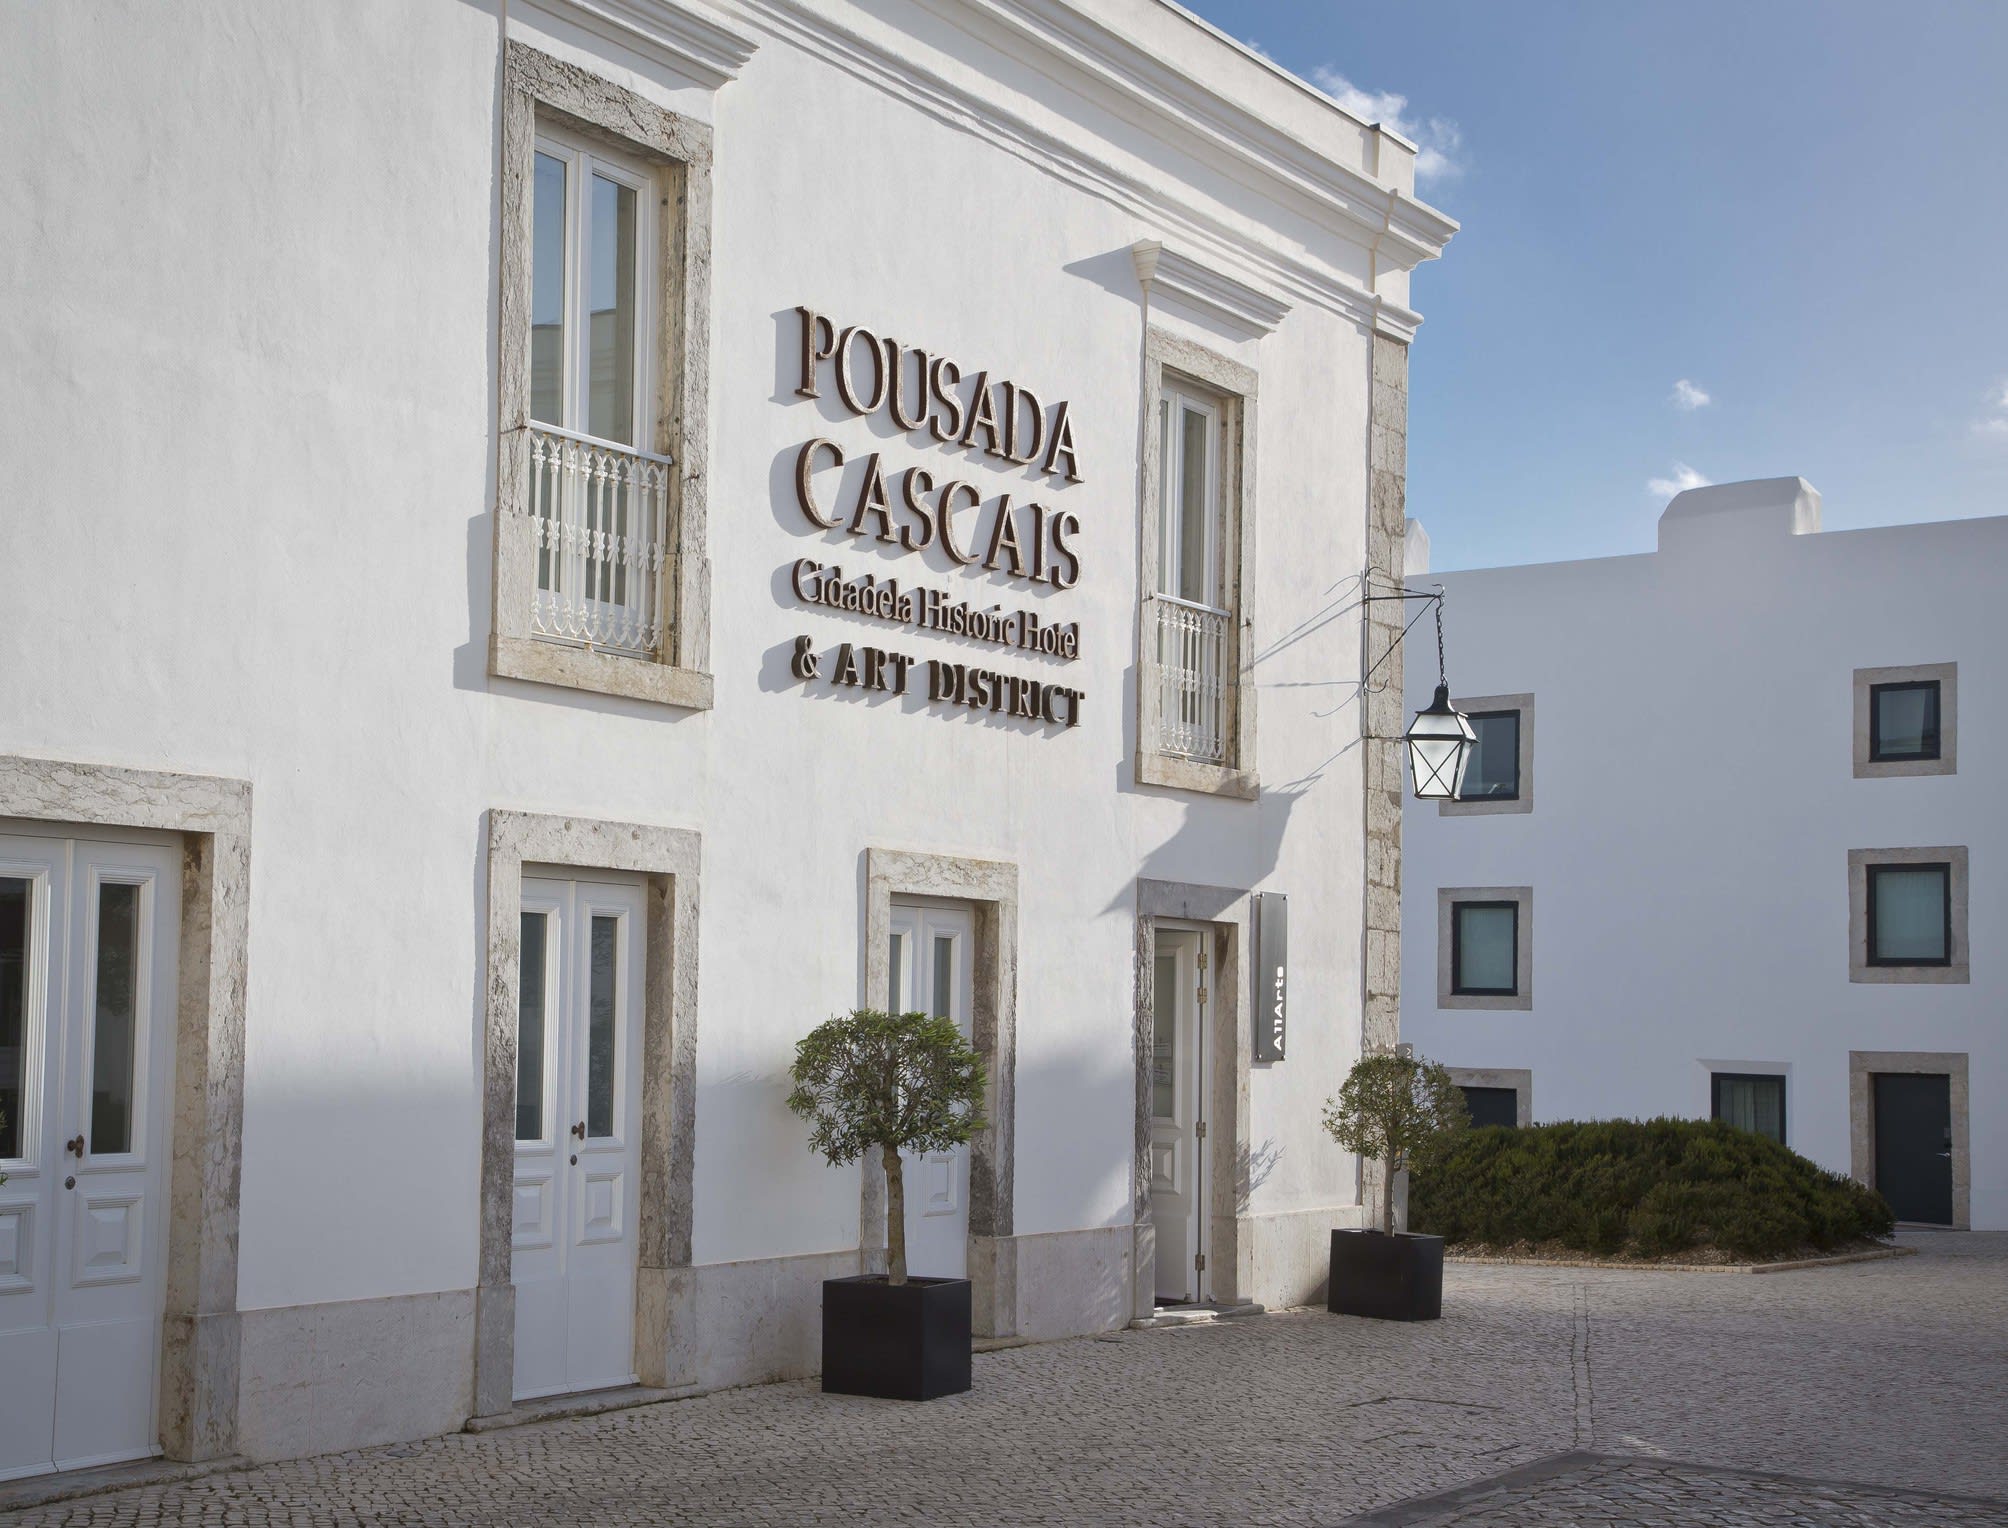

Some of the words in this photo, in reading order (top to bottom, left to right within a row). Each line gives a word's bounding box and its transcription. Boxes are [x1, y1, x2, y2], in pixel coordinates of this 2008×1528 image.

[795, 305, 1084, 483] POUSADA
[796, 438, 1081, 590] CASCAIS
[792, 557, 914, 624] Cidadela
[917, 586, 1016, 647] Historic
[1017, 609, 1081, 661] Hotel
[791, 634, 823, 680] &
[831, 643, 915, 695] ART
[928, 659, 1086, 728] DISTRICT
